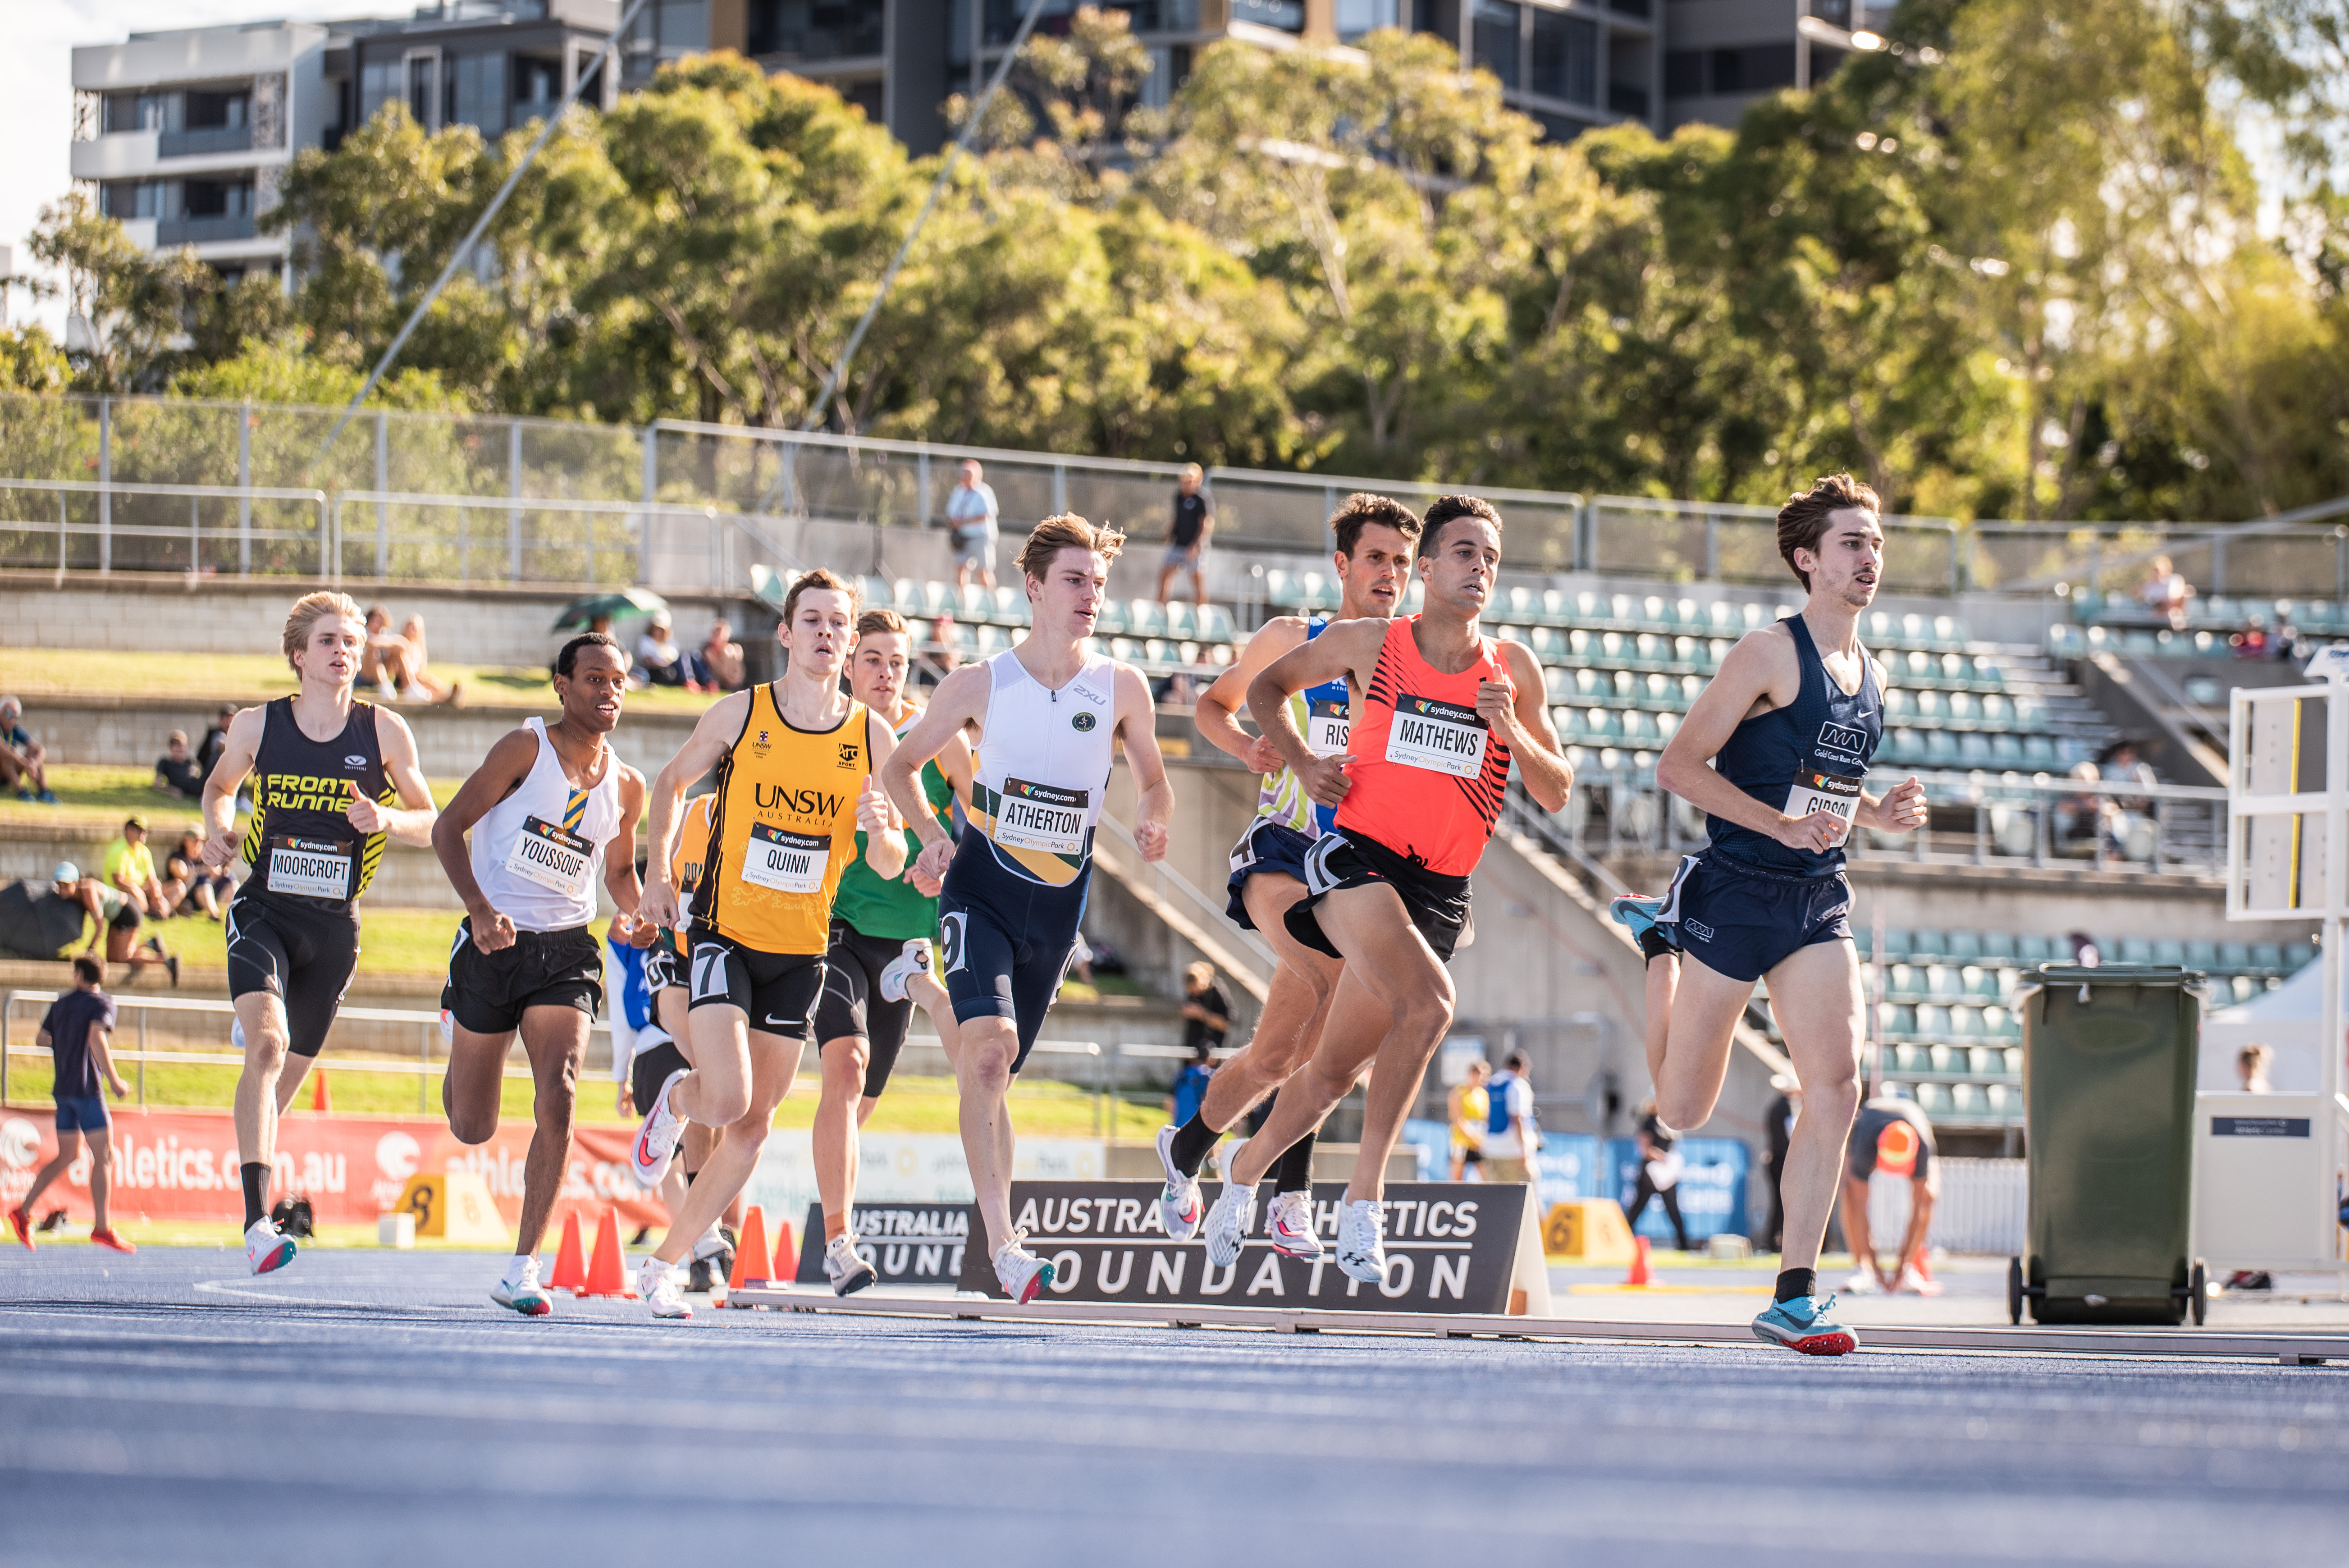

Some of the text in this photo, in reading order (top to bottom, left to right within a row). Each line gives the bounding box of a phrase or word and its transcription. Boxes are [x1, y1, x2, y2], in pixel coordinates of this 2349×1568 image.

[1073, 684, 1106, 705] 2XU
[1430, 706, 1475, 721] sydney.com
[1325, 724, 1350, 746] RIS
[1400, 719, 1478, 756] MATHEWS
[1814, 749, 1860, 766] Gold Coast Run Co.
[1034, 790, 1074, 803] sydney.com
[1827, 781, 1859, 792] sydney.com
[267, 791, 356, 813] RUNNE
[755, 783, 845, 818] UNSW
[758, 810, 833, 828] AUSTRALIA
[1005, 802, 1082, 834] ATHERTON
[300, 841, 337, 852] sydney.com
[552, 831, 583, 849] sydney.com
[781, 836, 819, 847] sydney.com
[273, 855, 348, 880] MOORCROFT
[521, 837, 584, 878] YOUSSOUF
[767, 849, 810, 874] QUINN
[942, 916, 961, 974] 9
[696, 946, 725, 996] 7
[68, 1132, 346, 1194] aletics.cm.au
[852, 1209, 969, 1237] USTRALIA
[1001, 1248, 1470, 1299] OUNDATON
